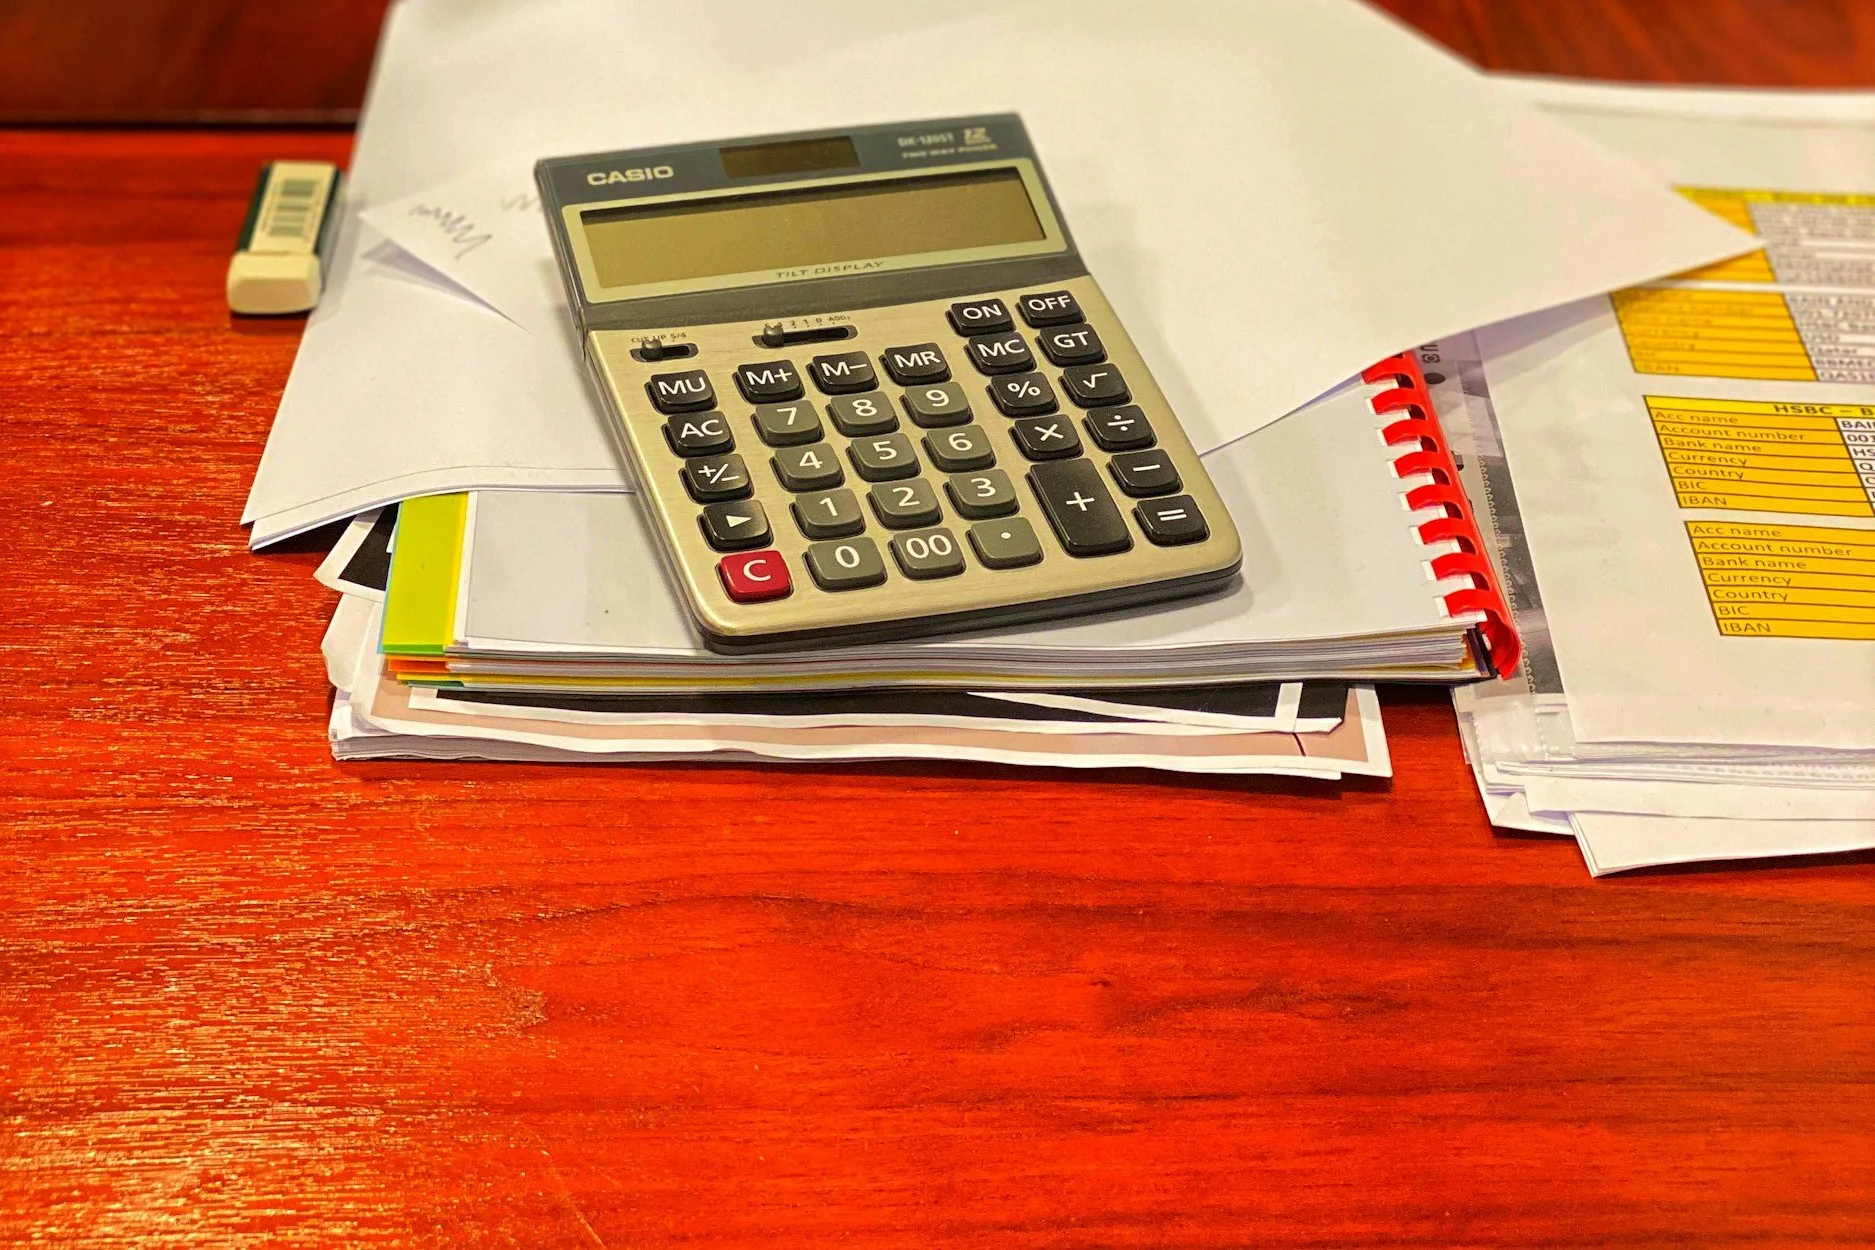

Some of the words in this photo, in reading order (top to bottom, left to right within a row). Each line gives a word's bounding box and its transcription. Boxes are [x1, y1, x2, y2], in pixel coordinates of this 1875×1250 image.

[586, 165, 675, 186] CASIO
[775, 268, 806, 279] TILT
[814, 261, 885, 275] DISPLAY
[962, 304, 1003, 320] ON
[1027, 296, 1072, 311] OFF
[978, 338, 1026, 357] MC
[1054, 331, 1090, 348] GT
[895, 350, 941, 368] MR
[746, 367, 793, 386] M+
[659, 377, 707, 395] MU
[925, 389, 950, 407] 9
[776, 406, 798, 426] 7
[852, 399, 878, 417] 8
[1773, 404, 1833, 415] HSBC
[1655, 411, 1684, 421] Acc
[1690, 415, 1739, 424] name
[680, 419, 724, 439] AC
[1659, 424, 1730, 437] Account
[1736, 428, 1806, 441] number
[872, 440, 898, 460] 5
[948, 432, 973, 451] 6
[1664, 438, 1708, 448] Bank
[1713, 443, 1762, 453] name
[799, 450, 823, 469] 4
[1668, 451, 1747, 467] Currency
[1673, 465, 1744, 481] Country
[970, 477, 996, 497] 3
[1678, 481, 1708, 491] BIC
[892, 487, 920, 507] 2
[1683, 495, 1728, 507] IBAN
[819, 496, 839, 517] 1
[1693, 525, 1725, 535] Acc
[1730, 528, 1783, 538] name
[905, 533, 953, 559] 00
[1698, 540, 1774, 552] Account
[1779, 544, 1852, 557] number
[835, 545, 860, 568] 0
[1703, 556, 1749, 567] Bank
[1755, 560, 1807, 570] name
[743, 559, 771, 582] C
[1708, 572, 1792, 588] Currency
[1713, 588, 1788, 603] Country
[1718, 605, 1750, 617] BIC
[1723, 621, 1772, 633] IBAN
